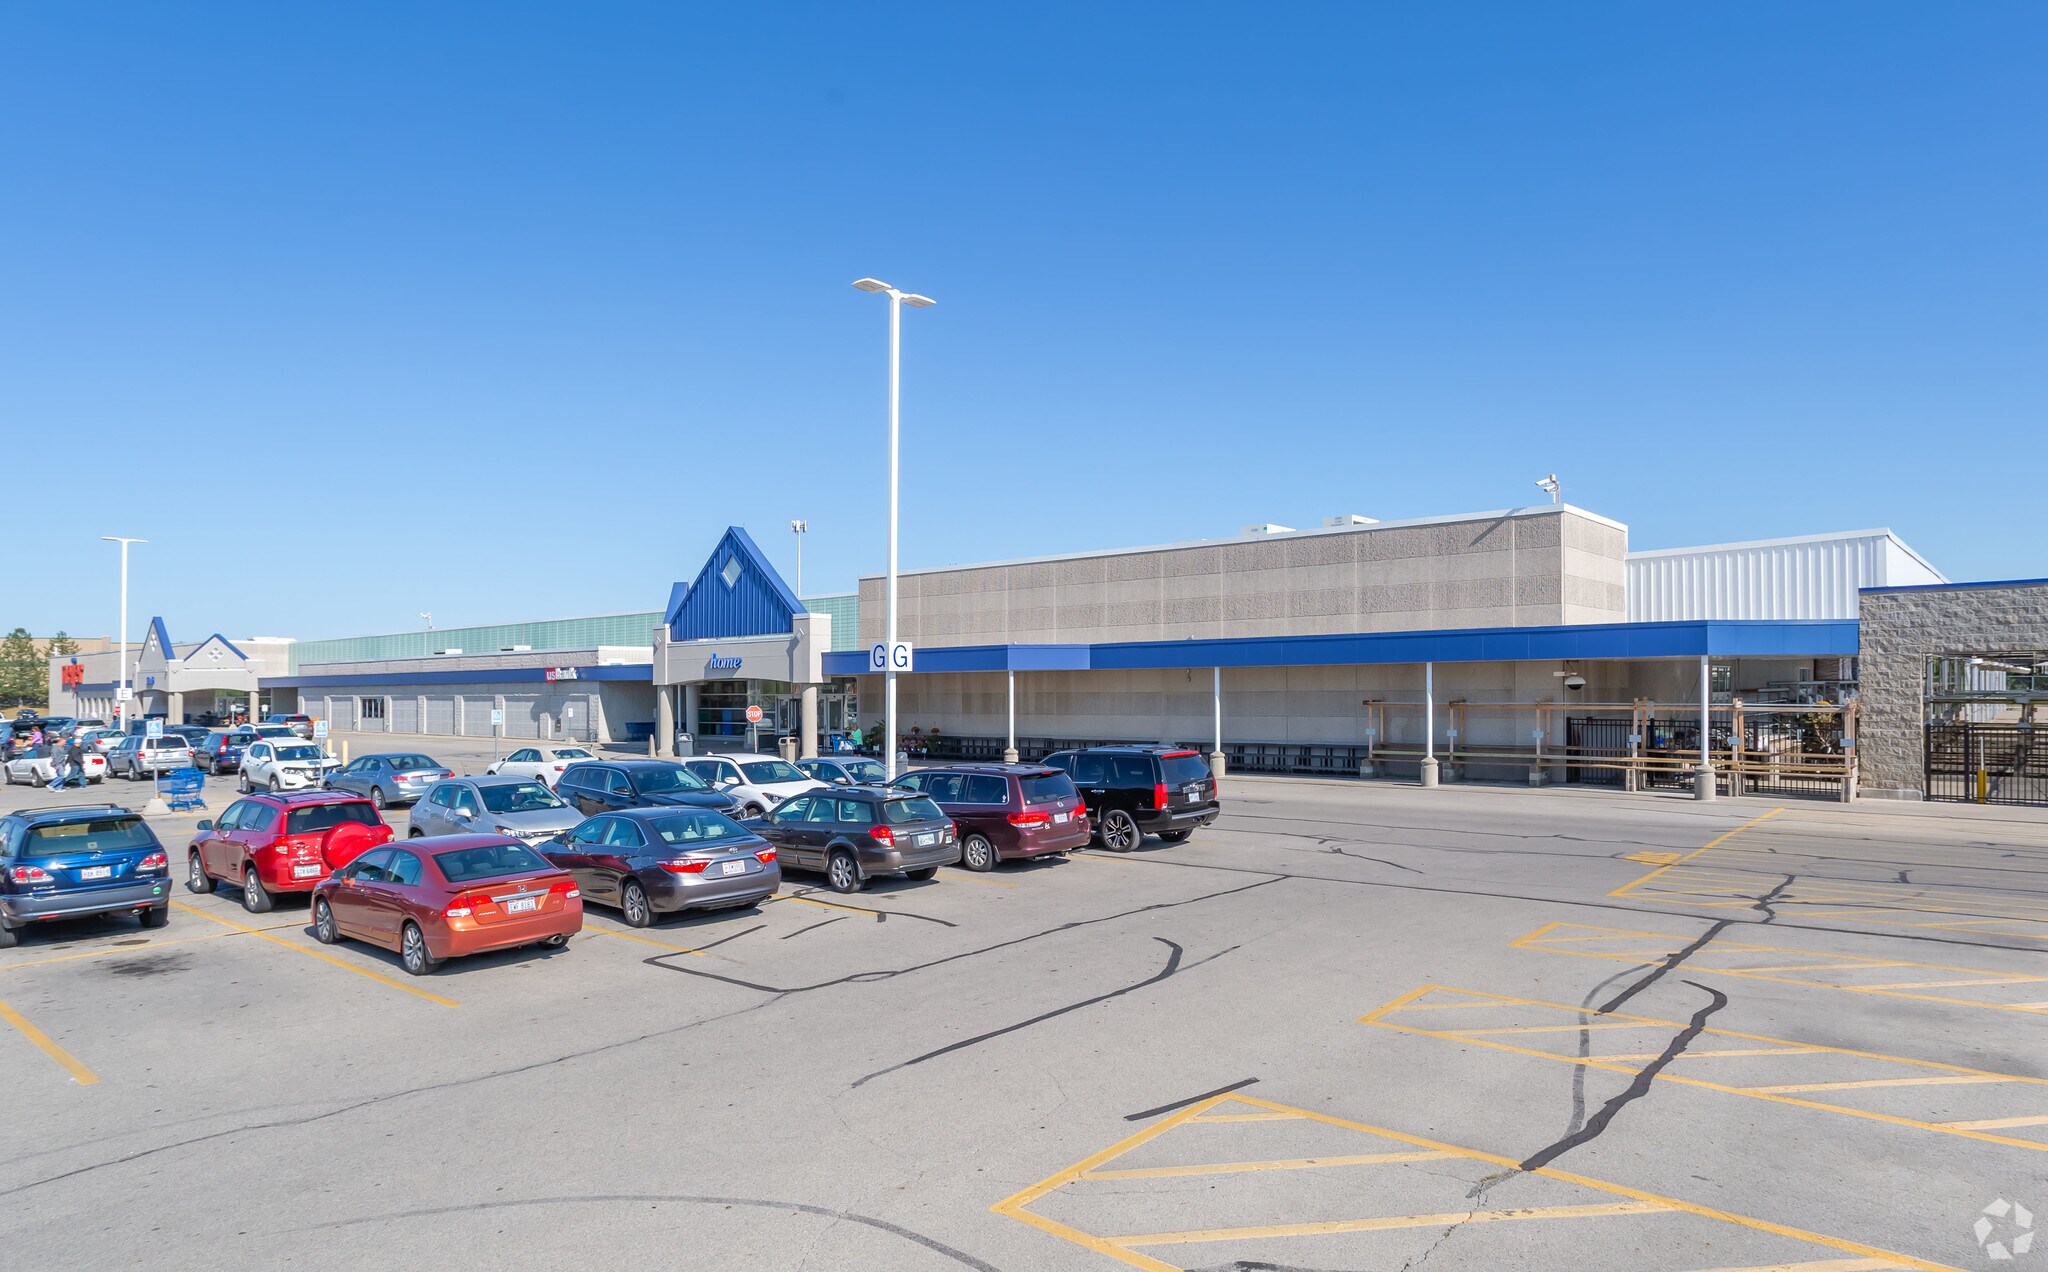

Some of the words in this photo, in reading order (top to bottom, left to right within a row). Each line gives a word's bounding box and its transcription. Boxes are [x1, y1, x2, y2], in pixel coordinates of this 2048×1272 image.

[711, 653, 742, 668] home
[873, 645, 885, 668] G
[893, 645, 908, 668] G
[121, 689, 129, 699] E
[747, 710, 762, 718] STOP
